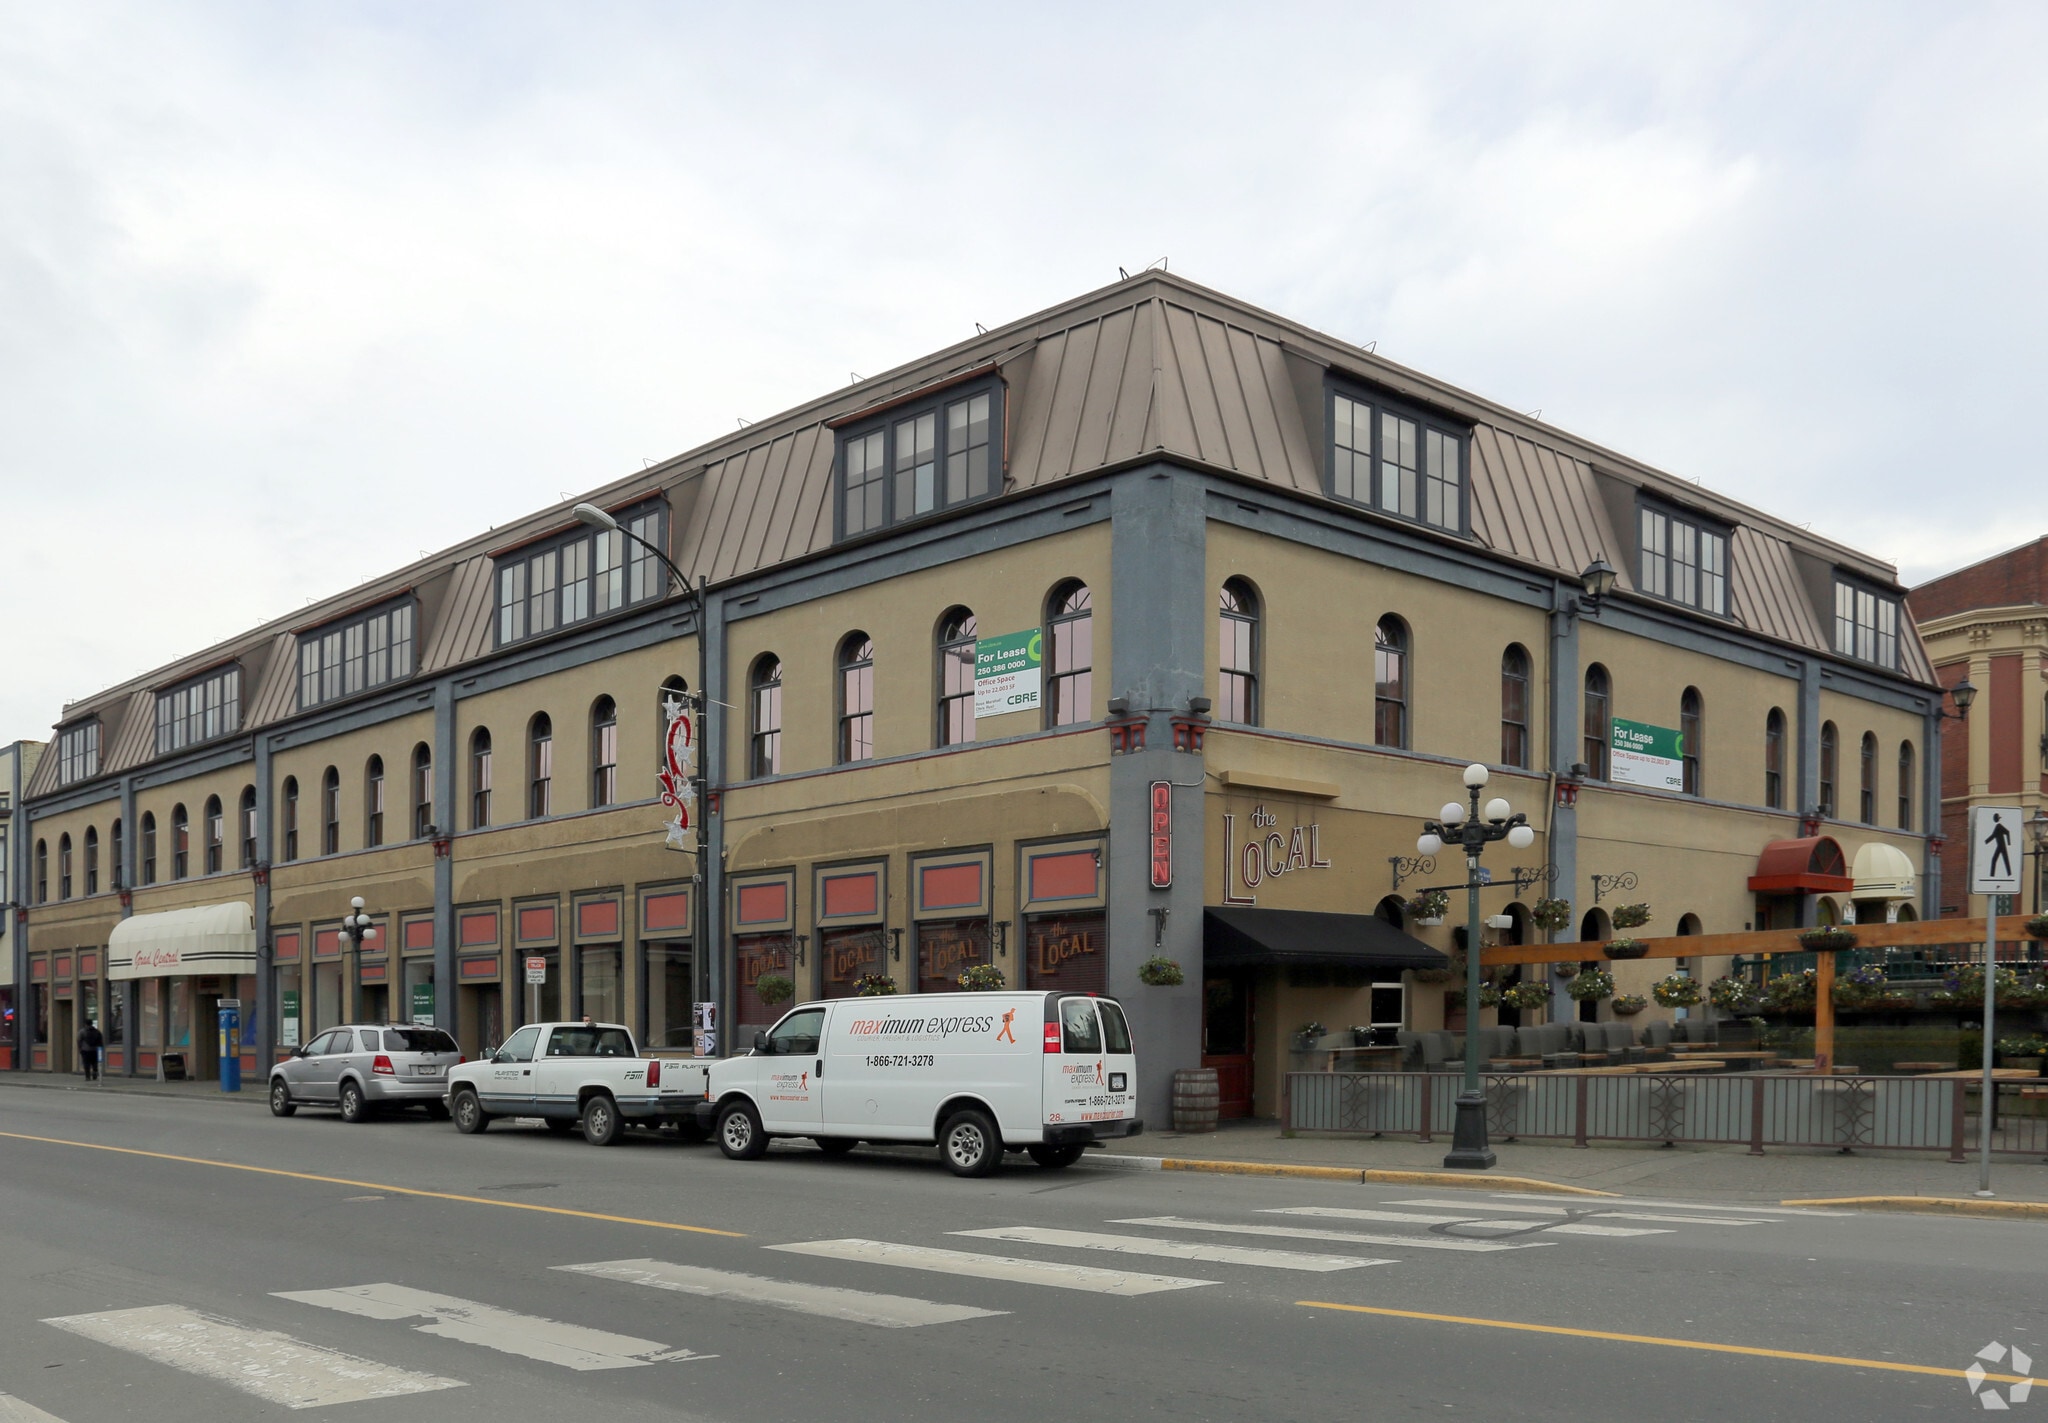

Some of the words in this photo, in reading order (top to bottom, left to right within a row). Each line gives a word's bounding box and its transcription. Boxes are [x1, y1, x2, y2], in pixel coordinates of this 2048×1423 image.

[977, 653, 994, 664] For
[997, 647, 1026, 660] Lease
[977, 666, 990, 676] 250
[992, 663, 1006, 673] 386
[1007, 660, 1026, 669] 0000
[978, 679, 996, 687] Office
[996, 676, 1015, 684] Space
[1007, 691, 1038, 706] CBRE
[1614, 726, 1628, 739] For
[1630, 730, 1653, 744] Lease
[1626, 753, 1639, 761] Space
[1665, 776, 1682, 786] CBRE
[1251, 804, 1277, 828] the
[1153, 787, 1169, 882] OPEN
[1222, 813, 1332, 906] LOCAL
[1051, 922, 1069, 937] the
[928, 939, 979, 978] LOCAL
[1037, 931, 1095, 974] LOCAL
[830, 943, 877, 982] LOCAL
[849, 1014, 925, 1035] maximum
[926, 1015, 994, 1039] express
[882, 1034, 905, 1042] FREIGHT
[905, 1034, 911, 1042] &
[911, 1034, 941, 1042] LOGISTICS
[865, 1055, 934, 1067] 1-866-721-3278
[1062, 1062, 1093, 1074] maximum
[770, 1072, 798, 1081] maximum
[1070, 1073, 1095, 1085] express
[776, 1081, 799, 1089] express
[1088, 1094, 1126, 1106] 1-866-721-3278
[1049, 1113, 1061, 1122] 28
[1081, 1110, 1124, 1121] www.maxcourier.com
